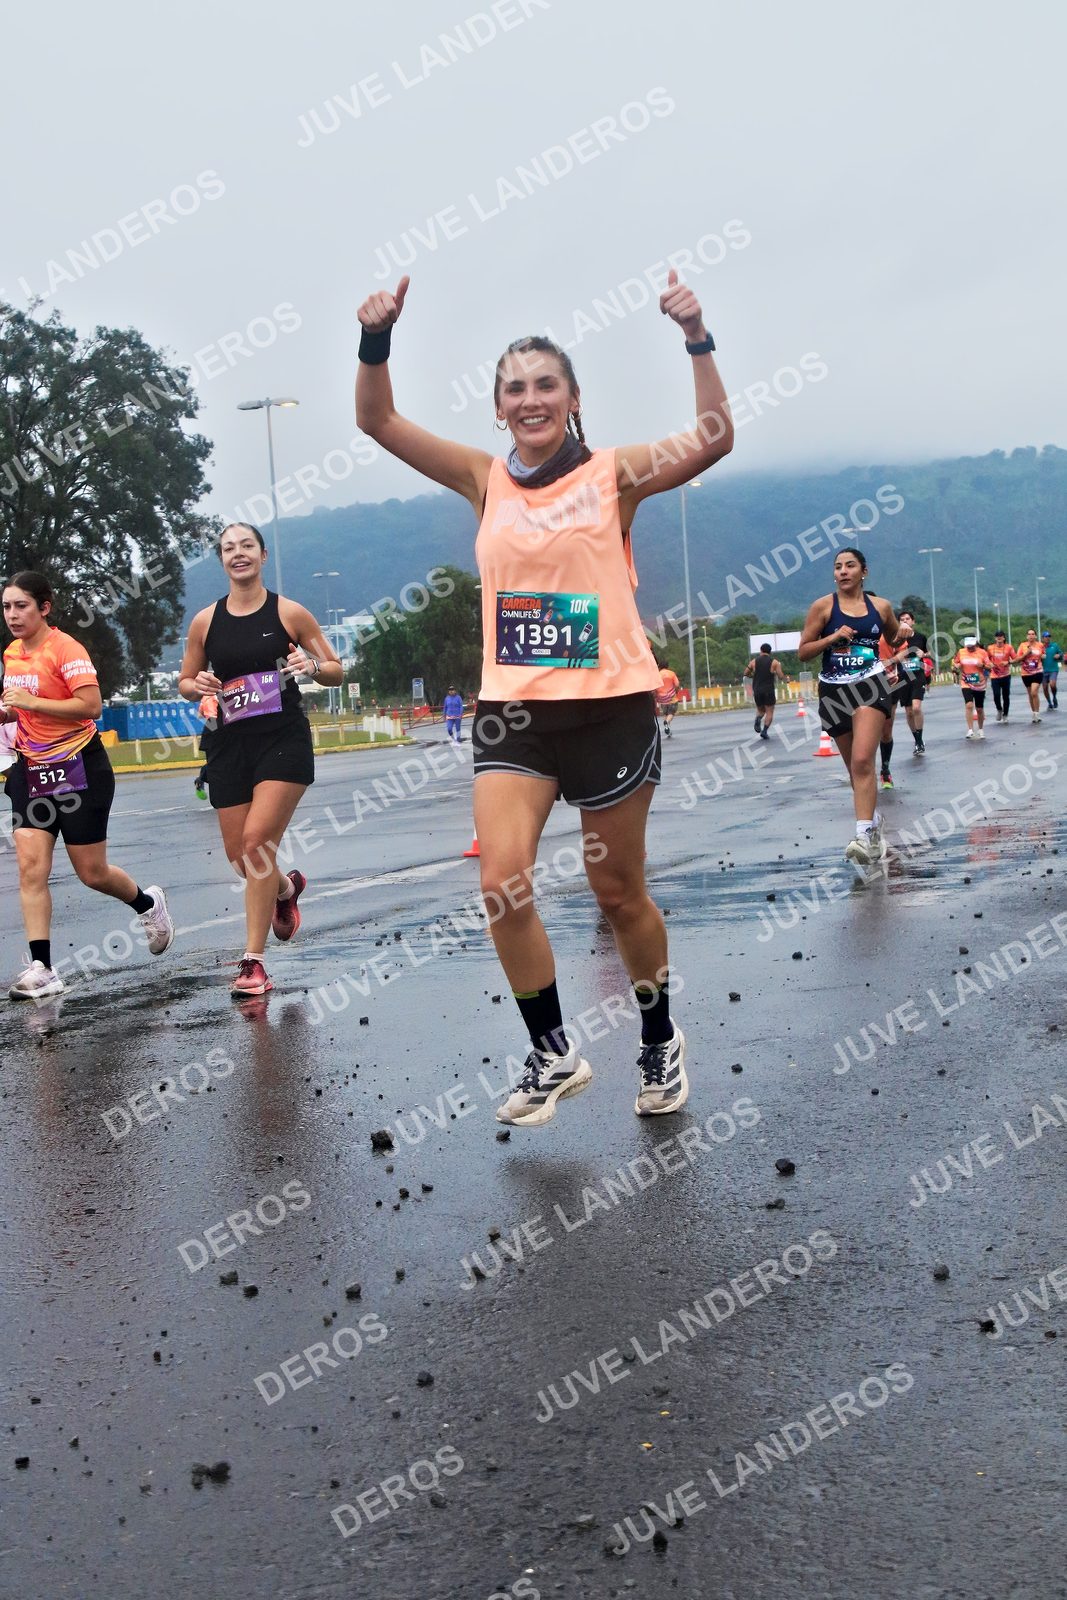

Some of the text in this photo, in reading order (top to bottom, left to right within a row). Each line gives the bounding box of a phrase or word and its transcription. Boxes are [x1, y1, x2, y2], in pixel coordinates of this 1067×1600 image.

[502, 597, 542, 610] CARRERA
[570, 599, 590, 614] 10K
[515, 623, 572, 646] 1391
[838, 656, 864, 667] 1126
[261, 674, 273, 684] 16K
[233, 691, 260, 709] 274
[39, 768, 67, 784] 512
